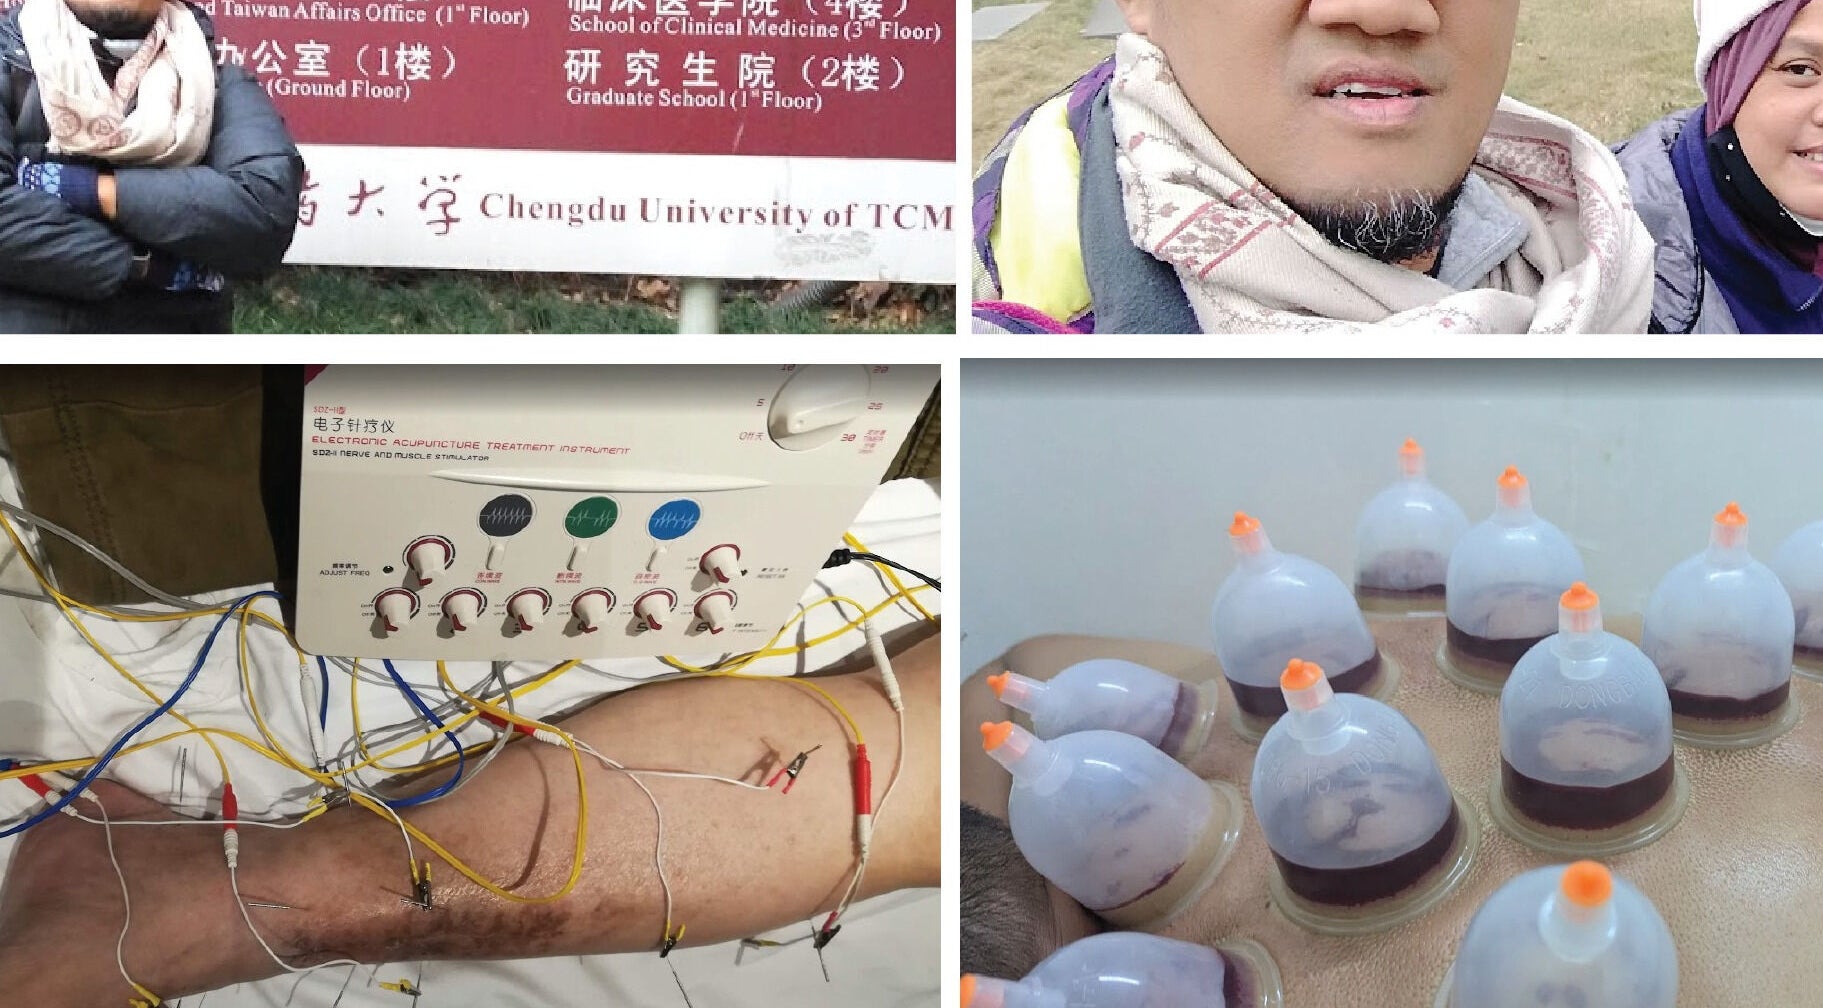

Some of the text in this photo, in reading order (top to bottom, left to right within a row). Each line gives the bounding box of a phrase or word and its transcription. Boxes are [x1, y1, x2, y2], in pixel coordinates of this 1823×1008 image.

[221, 0, 290, 19] Taiwan
[294, 2, 361, 22] Affairs
[366, 4, 427, 23] Office
[470, 7, 530, 29] Floor)
[570, 14, 635, 33] School
[640, 15, 660, 33] of
[665, 16, 742, 36] Clinical
[748, 18, 838, 38] Medicine
[880, 21, 942, 43] Floor)
[266, 78, 411, 102] (Ground Floor)
[566, 87, 654, 107] Graduate
[658, 89, 726, 108] School
[762, 90, 823, 113] Floor)
[479, 192, 954, 234] Chengdu University of TCM
[313, 416, 396, 434] 电子针疗仪
[312, 435, 631, 455] ELECTRONIC ACUPUNCTURE TREATMENT INSTRUMENT
[340, 450, 371, 458] NERVE
[374, 451, 393, 459] AND
[394, 452, 432, 460] MUSCLE
[435, 453, 490, 461] STIMULATOR
